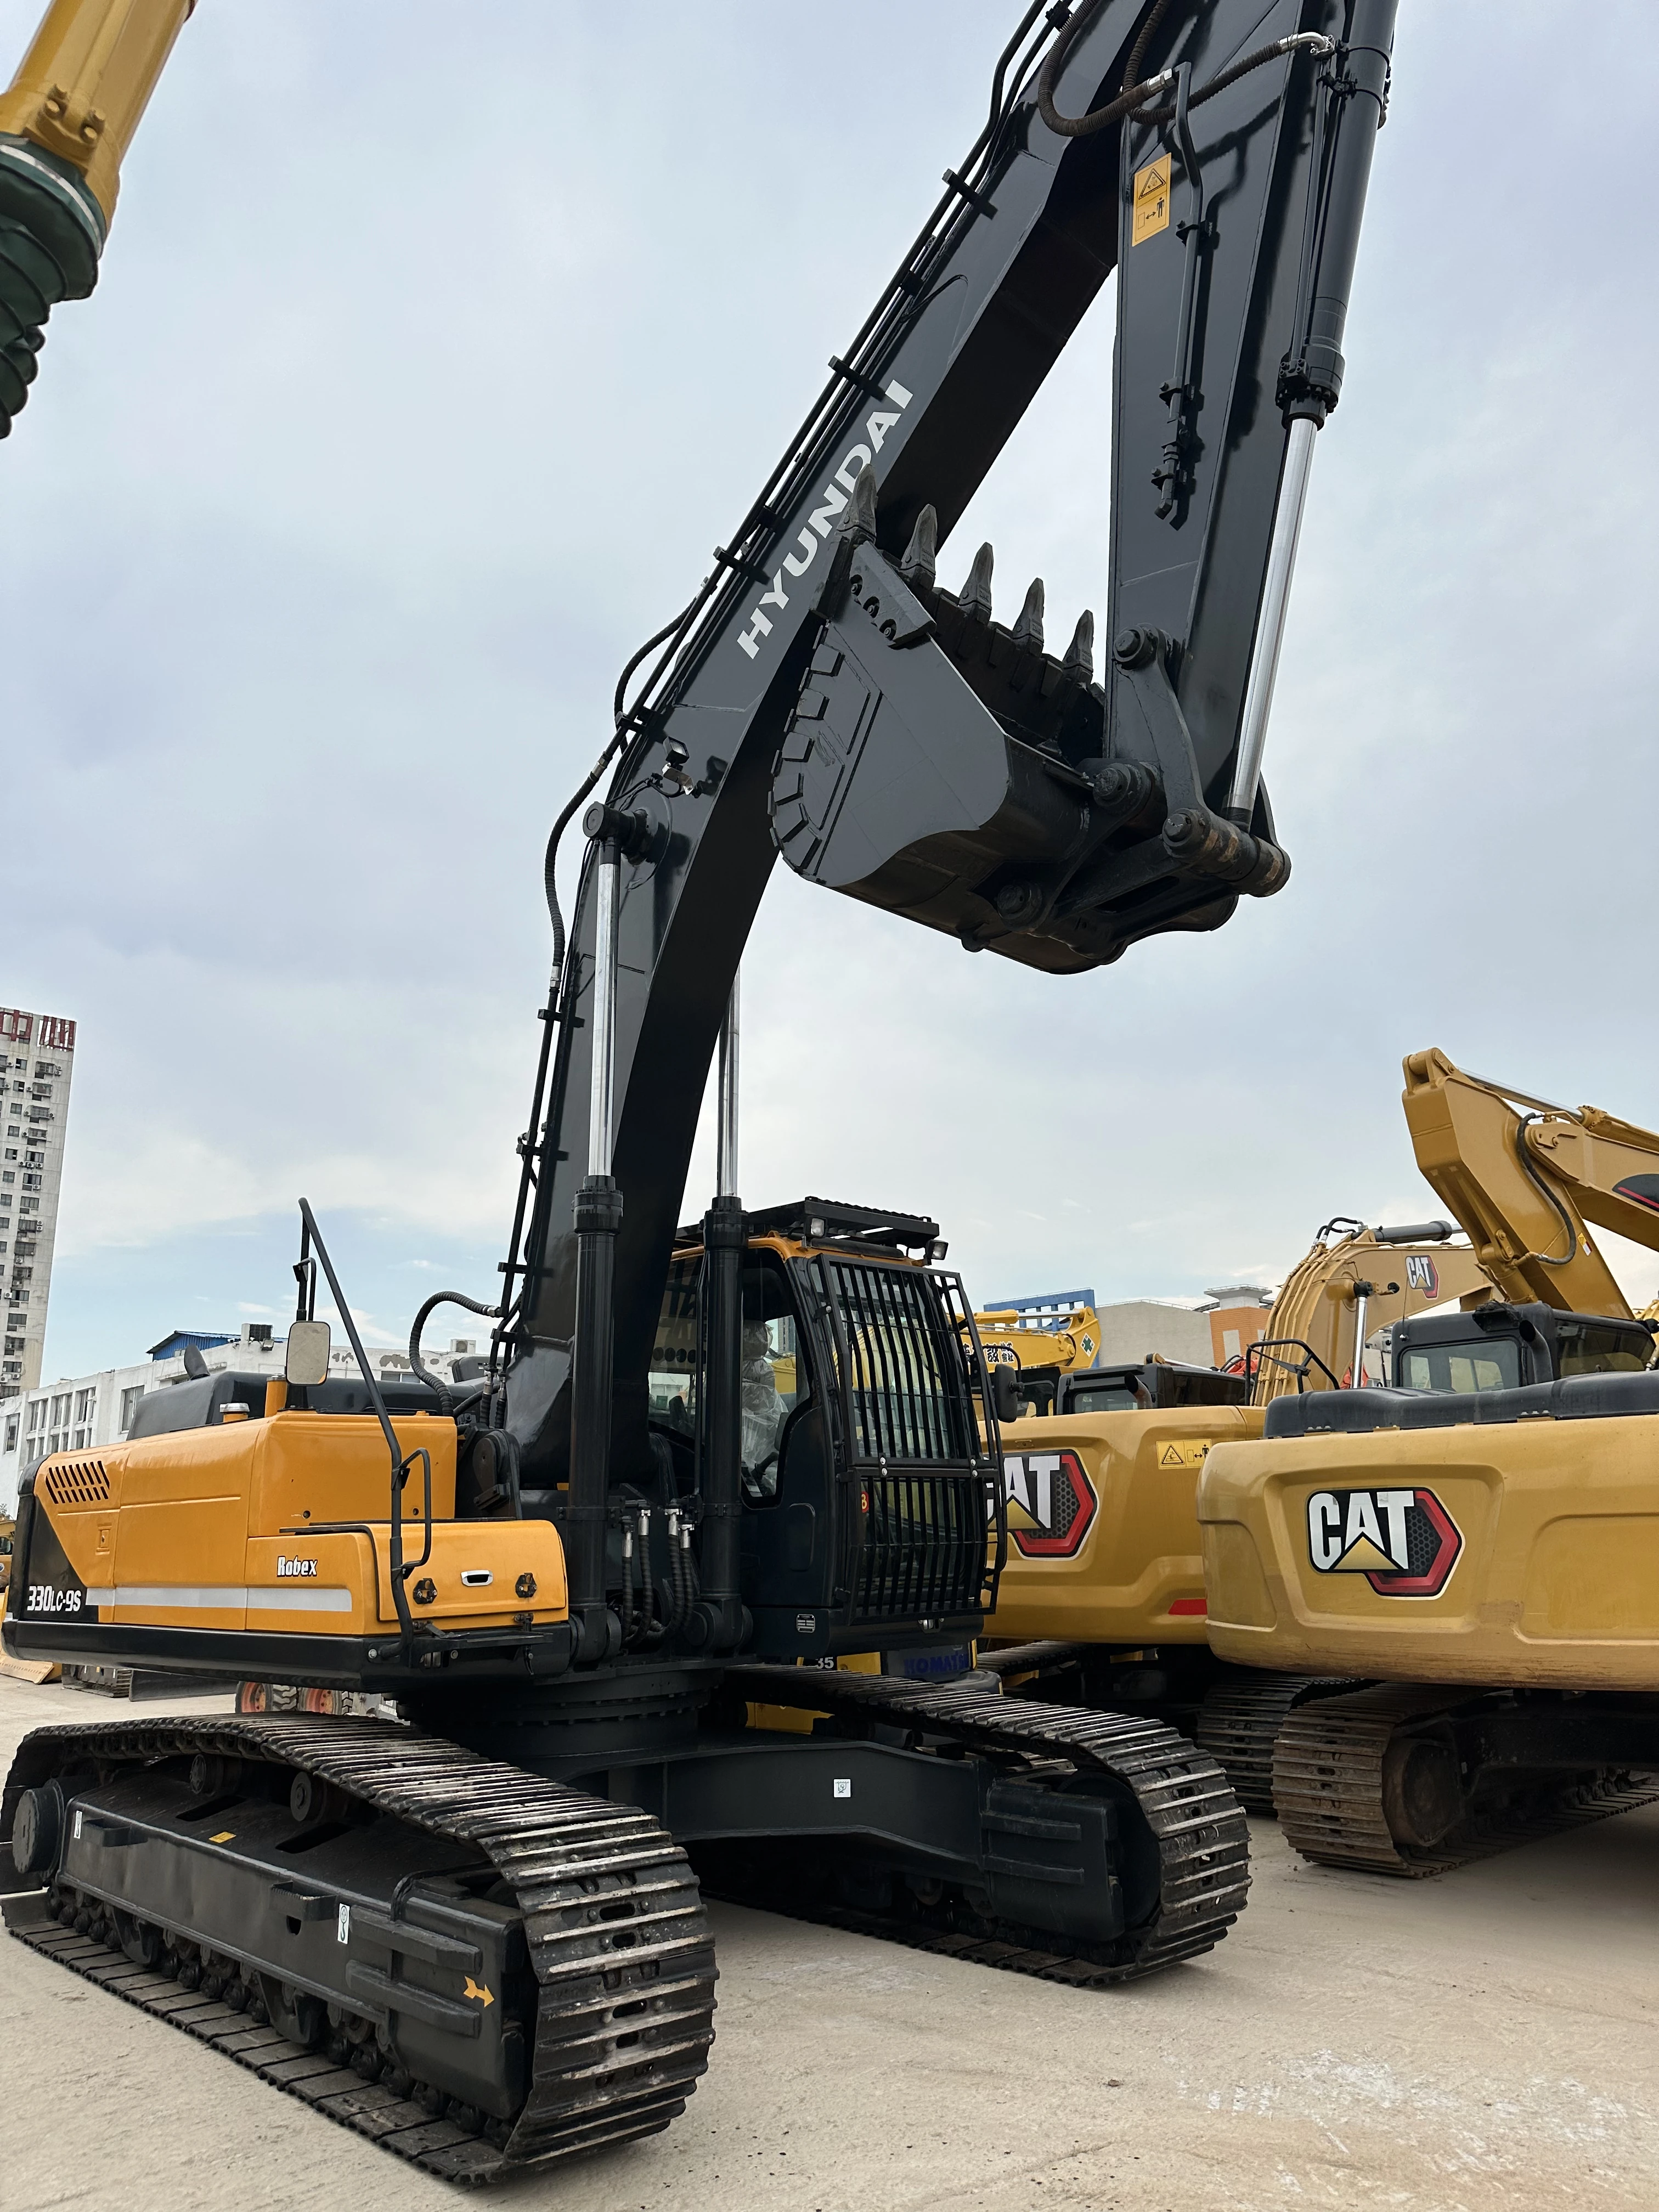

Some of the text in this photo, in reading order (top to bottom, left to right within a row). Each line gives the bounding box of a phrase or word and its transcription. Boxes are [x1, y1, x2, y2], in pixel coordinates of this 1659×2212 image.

[737, 379, 913, 660] HYUNDAI
[1406, 1256, 1431, 1289] CAT
[1309, 1490, 1414, 1570] CAT
[277, 1555, 318, 1577] Robex
[27, 1585, 82, 1612] 330LC-9S
